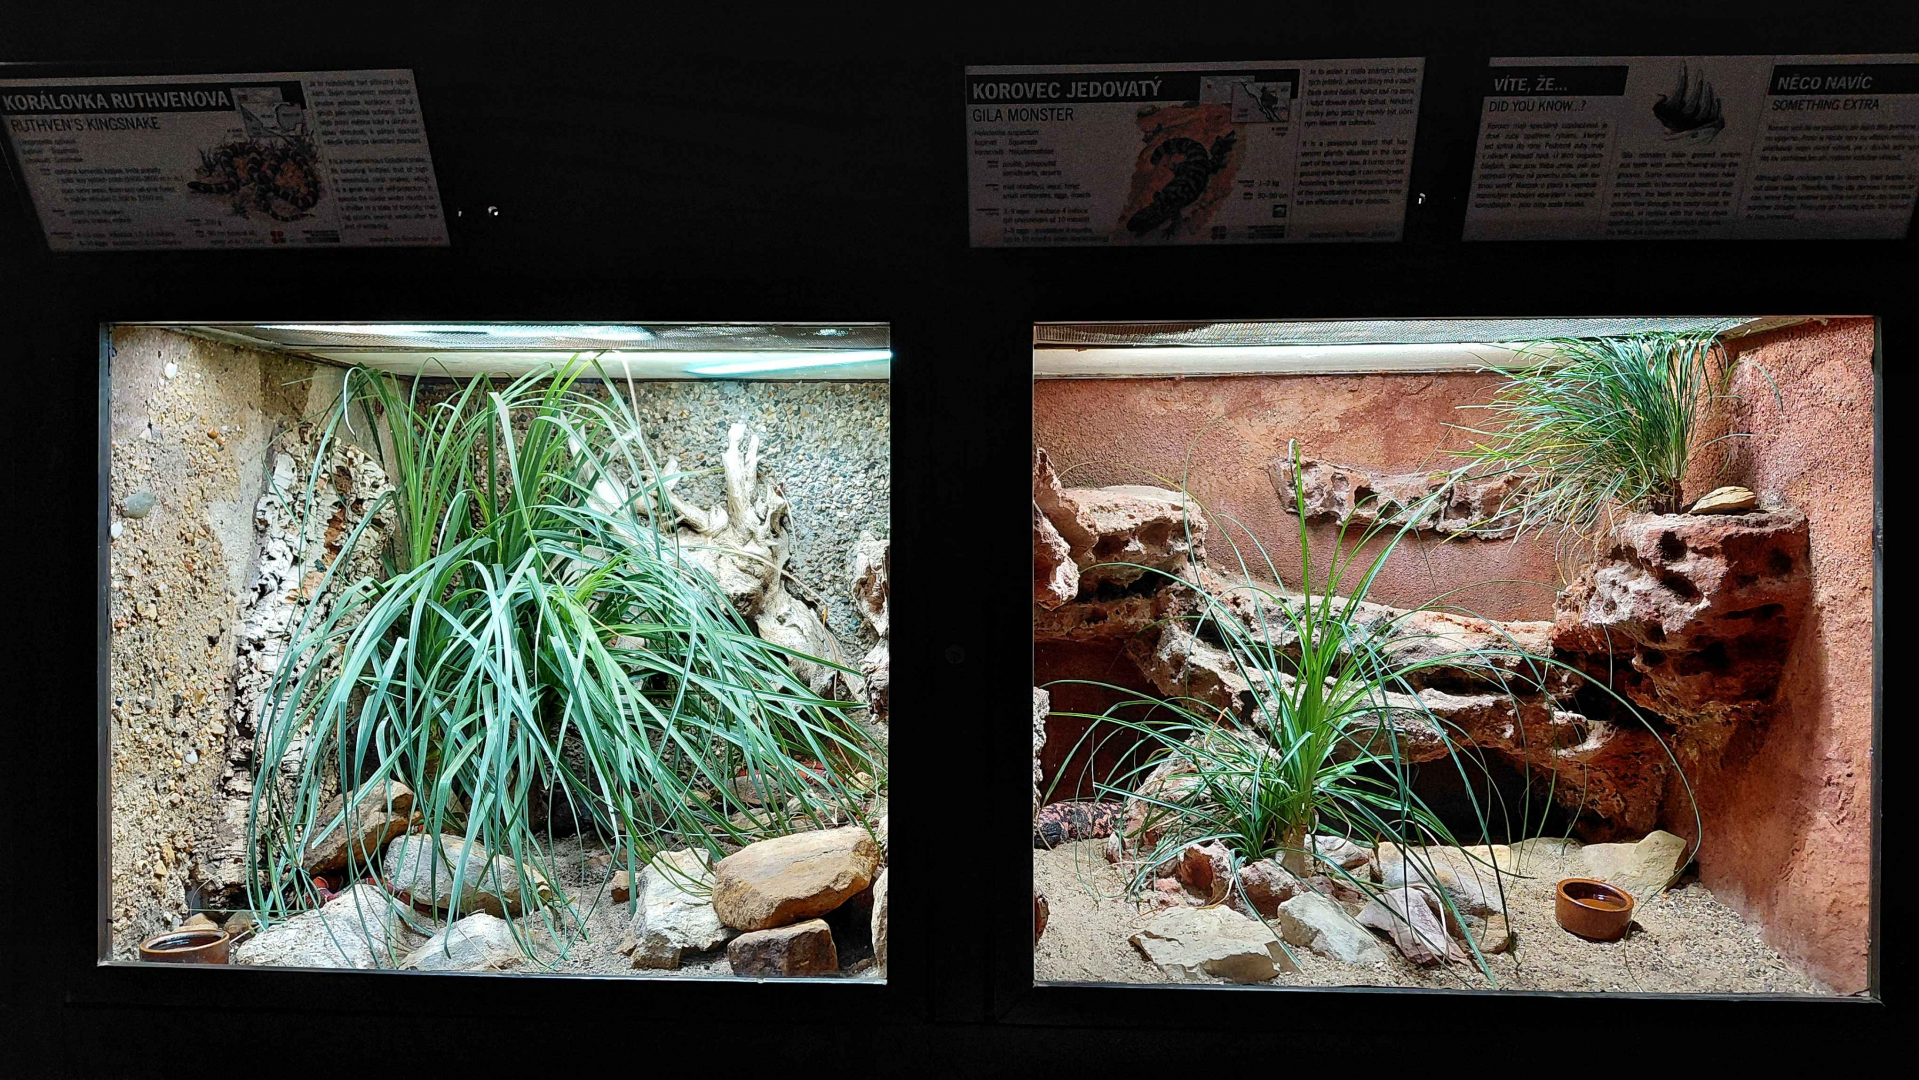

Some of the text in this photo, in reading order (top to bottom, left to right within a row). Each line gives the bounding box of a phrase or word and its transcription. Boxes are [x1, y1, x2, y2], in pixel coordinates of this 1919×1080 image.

[973, 75, 1162, 99] KOROVEC JEDOVATÝ
[1494, 74, 1567, 93] VÍTE, ŽE...
[1778, 72, 1873, 90] NĚCO NAVÍC
[2, 90, 230, 111] KORÁLOVKA RUTHVENOVA
[1489, 100, 1509, 112] DID
[1513, 100, 1535, 112] YOU
[1772, 99, 1879, 111] SOMETHING EXTRA
[973, 108, 1074, 122] GILA MONSTER
[11, 116, 160, 132] RUTHVEN'S KINGSNAKE
